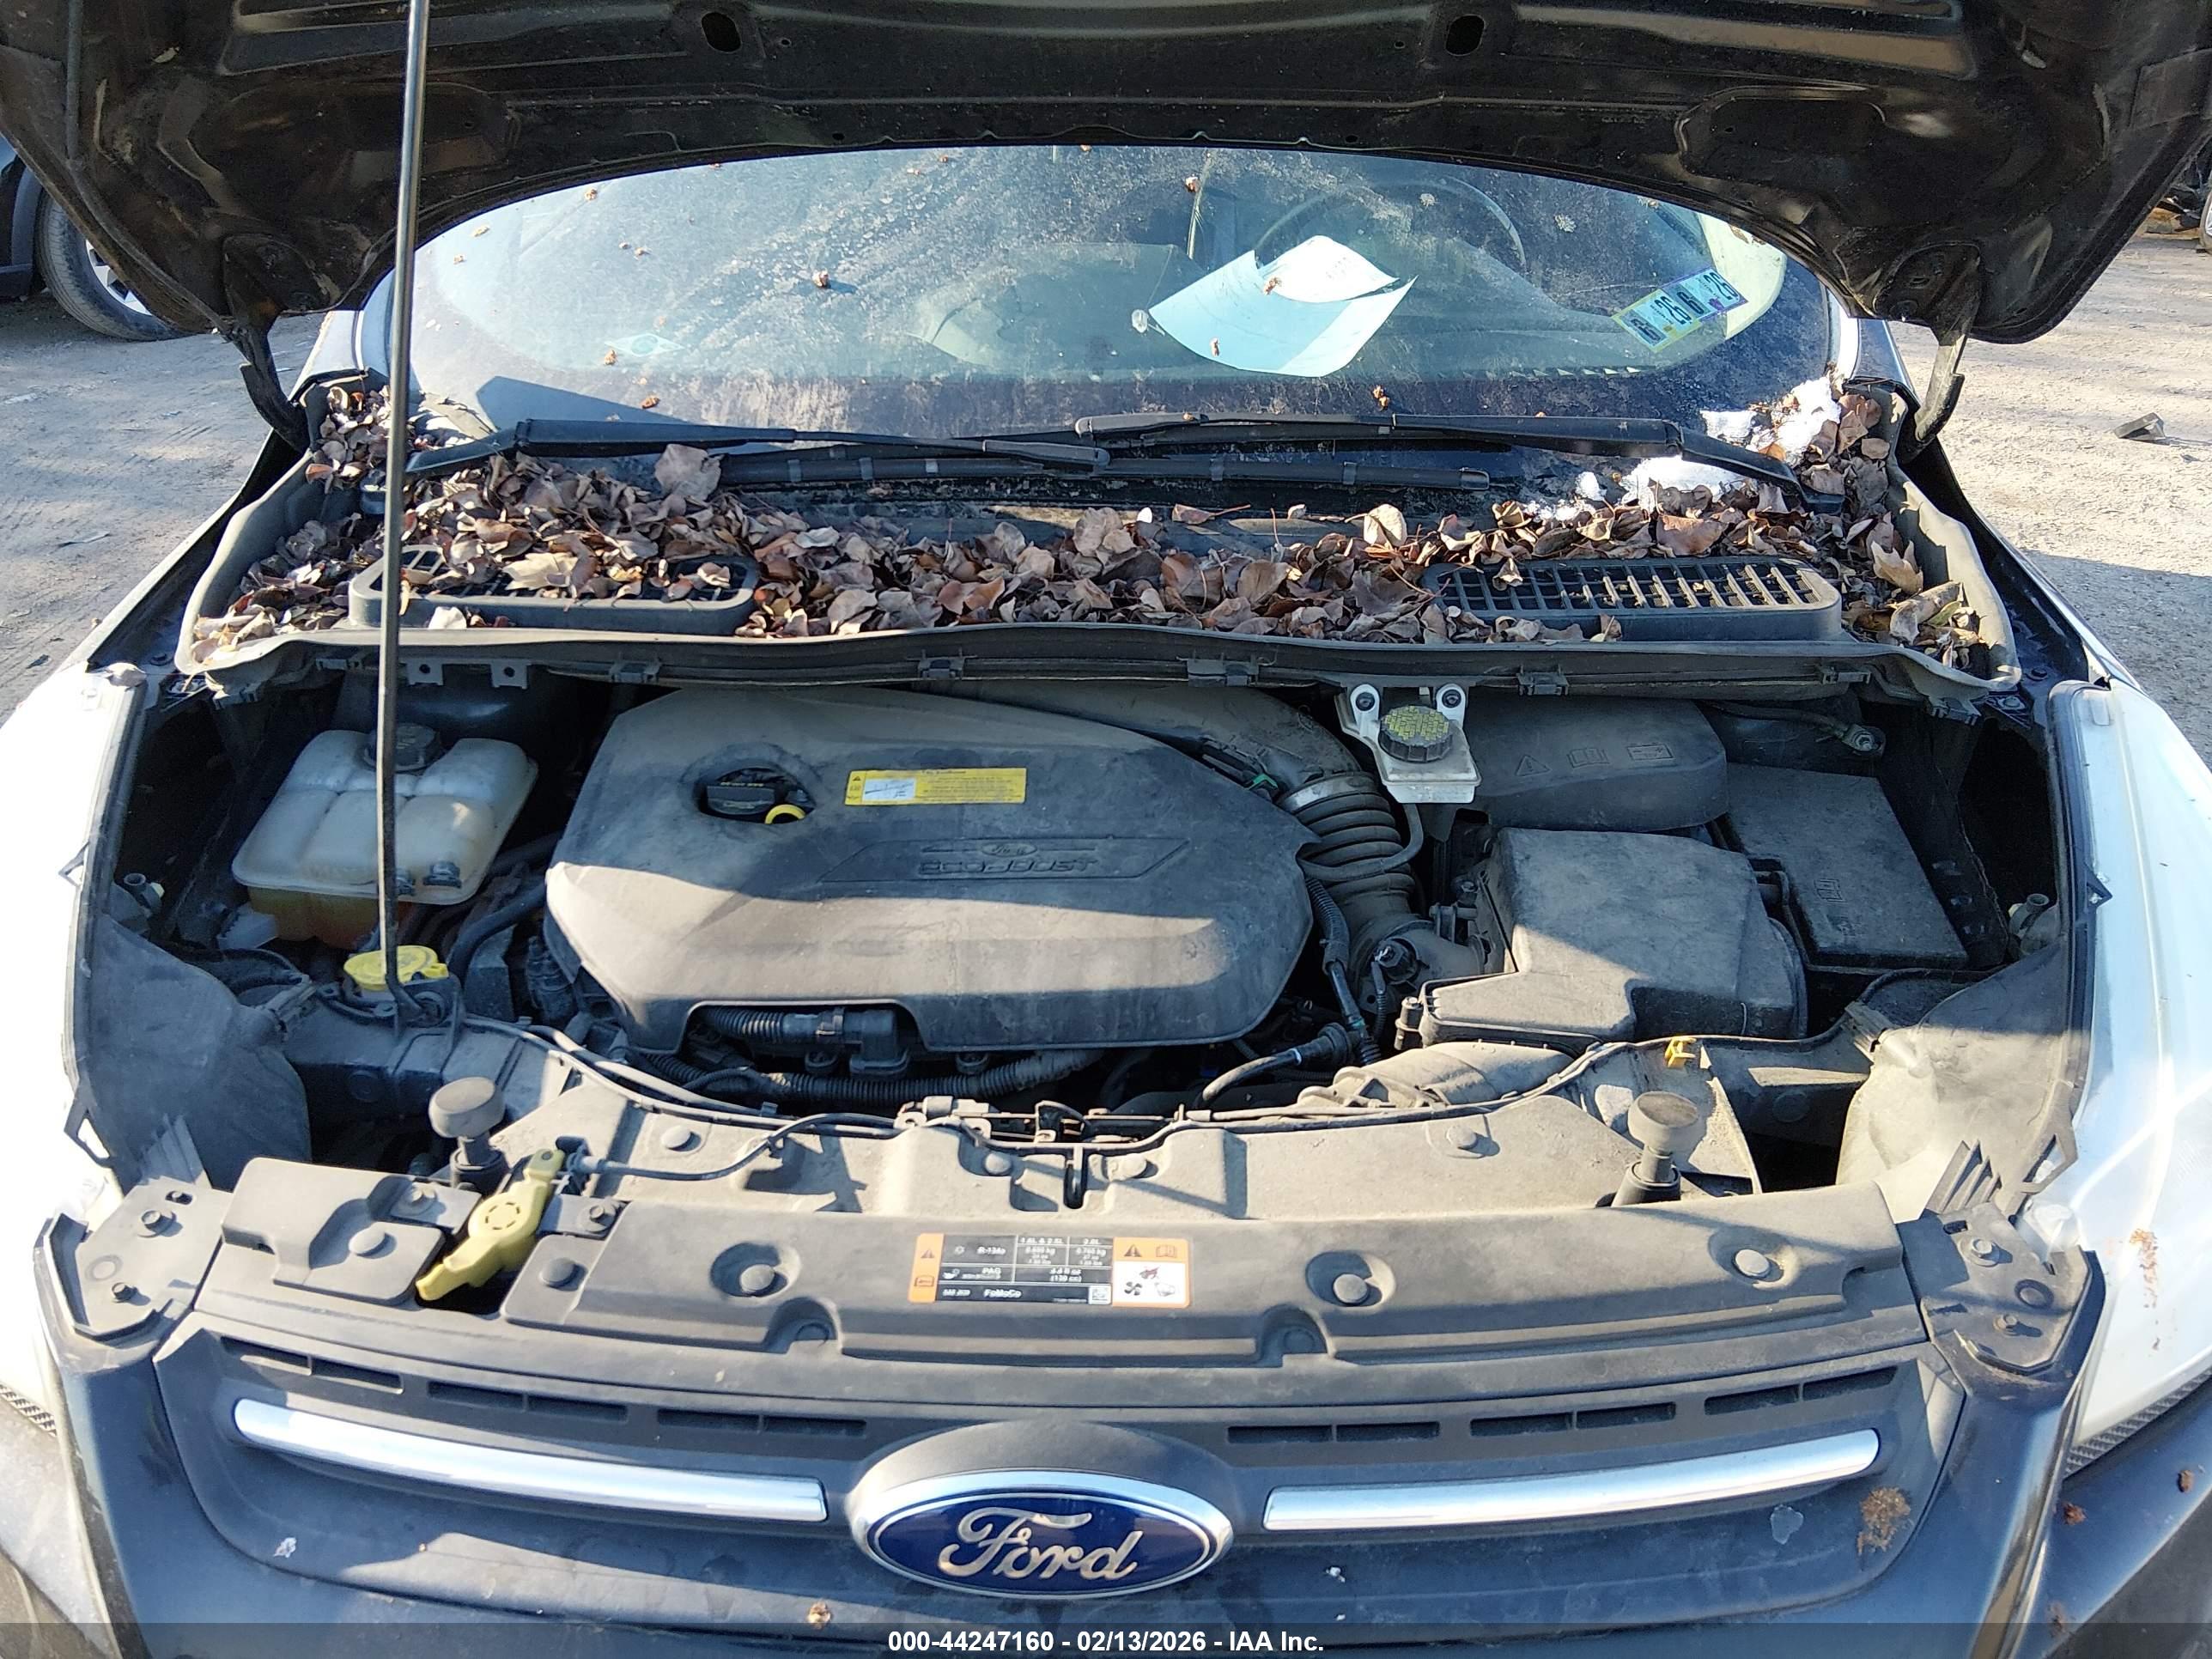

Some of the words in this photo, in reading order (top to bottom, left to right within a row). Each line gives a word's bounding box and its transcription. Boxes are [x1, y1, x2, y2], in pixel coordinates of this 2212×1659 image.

[1703, 271, 1738, 301] 26
[1654, 295, 1692, 325] 26
[937, 1506, 1144, 1580] Ford
